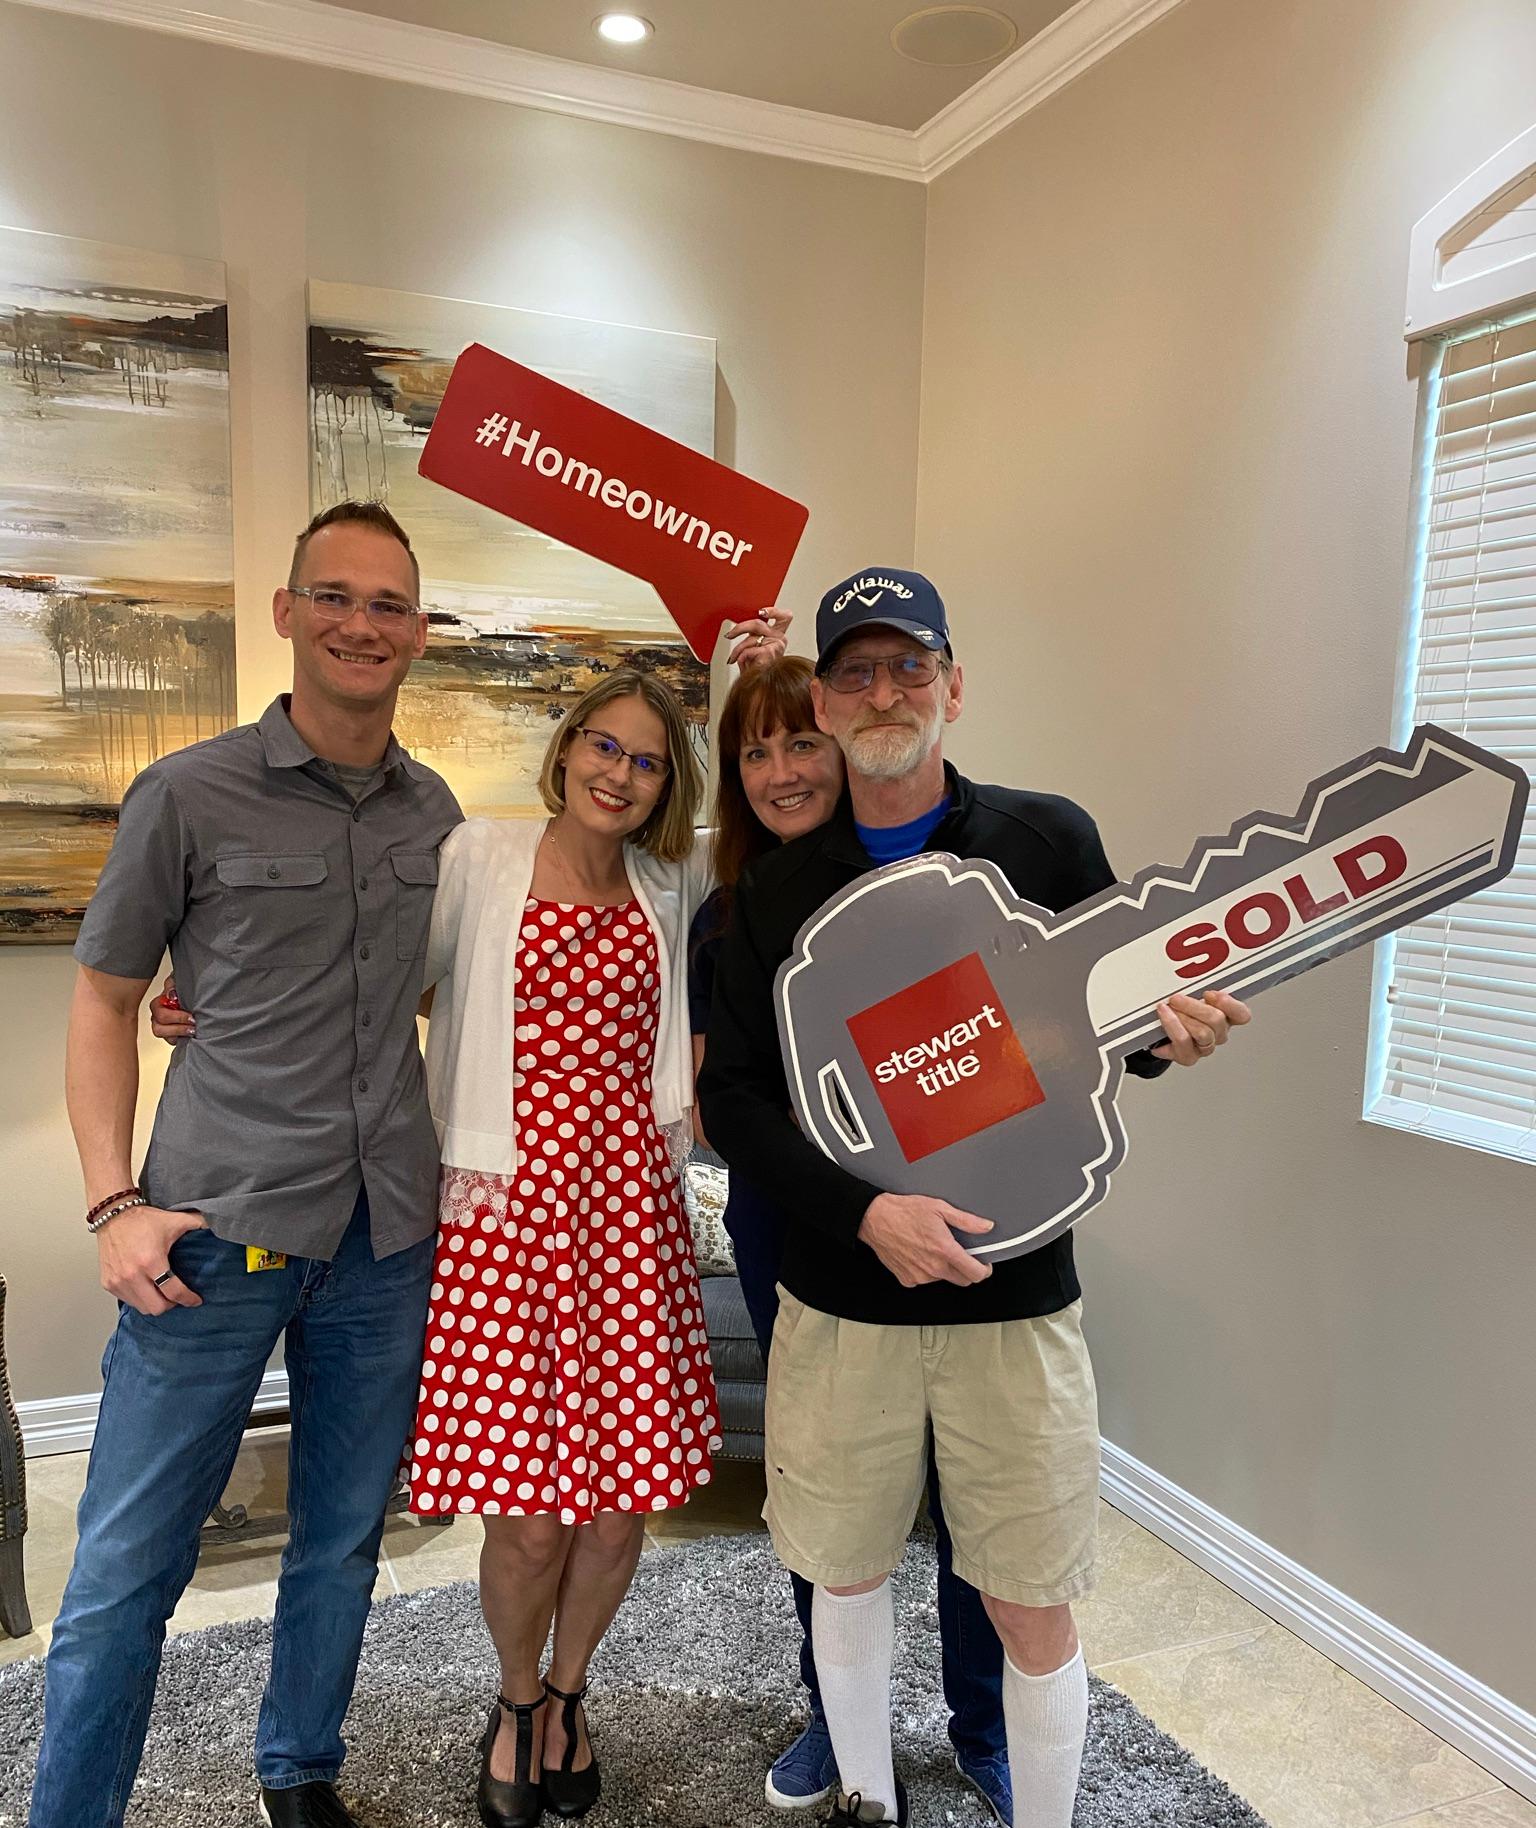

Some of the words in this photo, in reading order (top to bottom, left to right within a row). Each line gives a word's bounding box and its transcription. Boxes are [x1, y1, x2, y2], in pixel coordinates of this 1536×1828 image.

[475, 412, 753, 566] #Homeowner
[833, 577, 914, 613] Callaway
[1165, 835, 1407, 979] SOLD
[874, 1004, 1002, 1083] stewart
[916, 1053, 981, 1096] title
